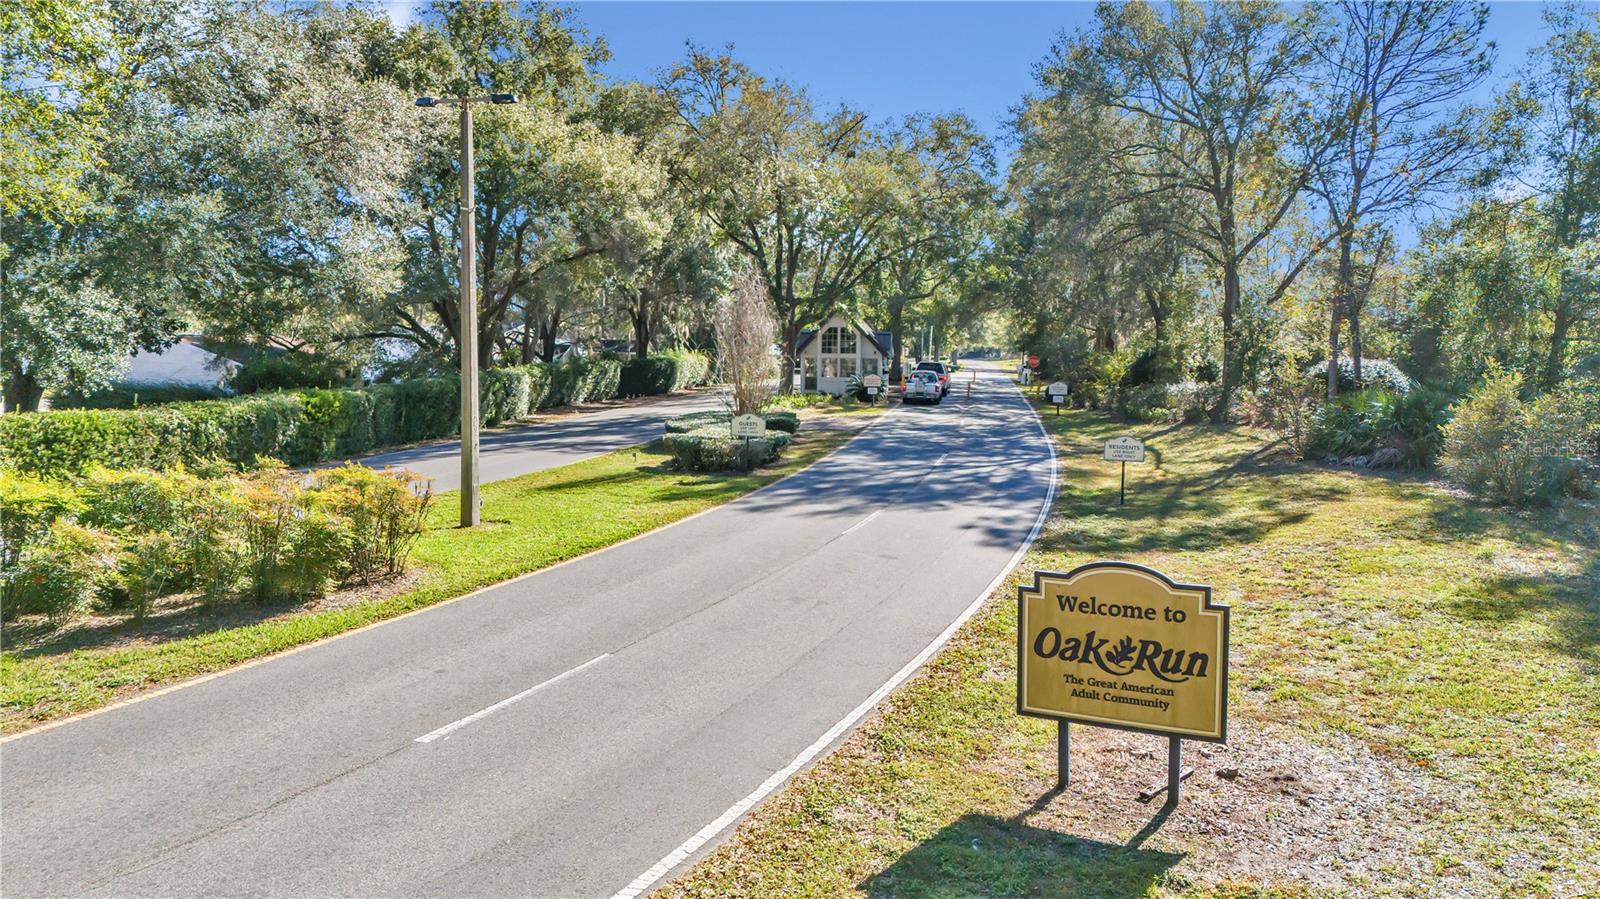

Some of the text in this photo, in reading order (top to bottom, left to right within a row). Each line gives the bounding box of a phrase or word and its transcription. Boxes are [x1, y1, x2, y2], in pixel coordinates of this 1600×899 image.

[1057, 595, 1187, 623] Welcome to
[1033, 626, 1209, 683] Oak Run
[1064, 673, 1175, 697] The Great American
[1071, 688, 1170, 712] Adult Community
